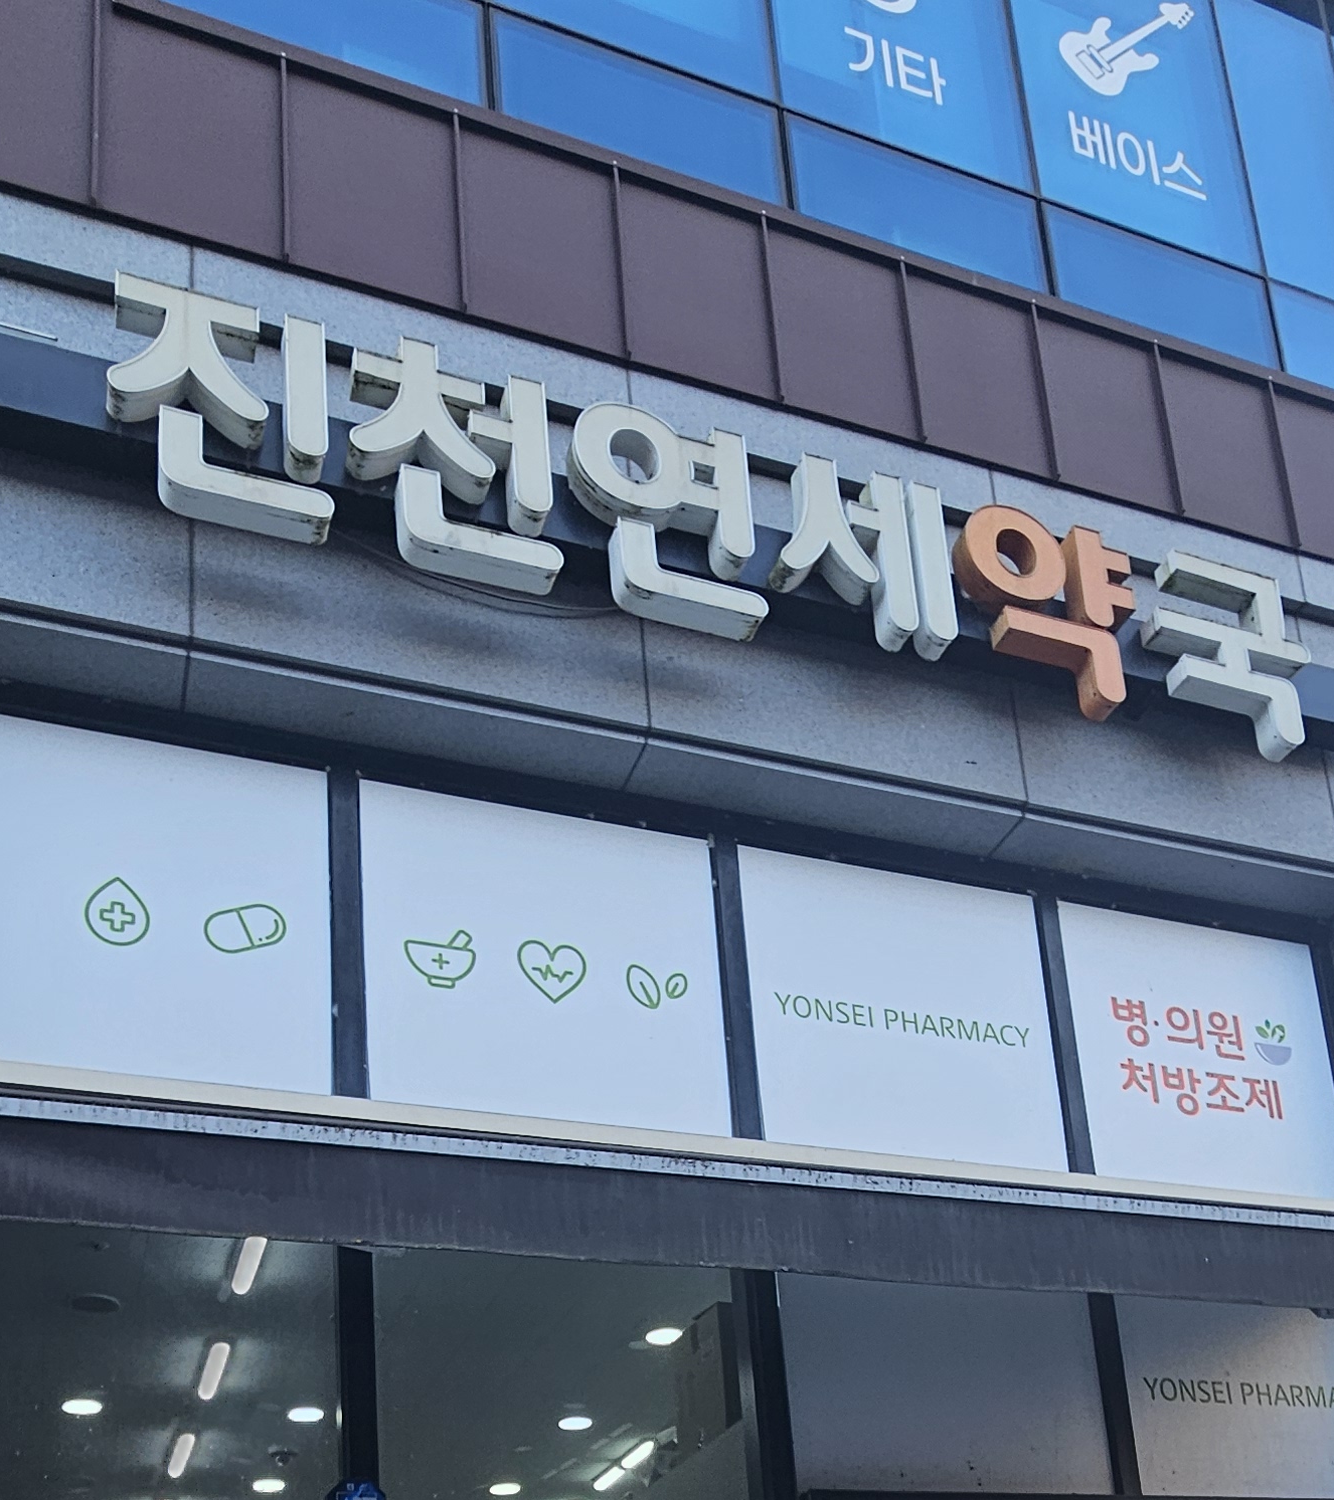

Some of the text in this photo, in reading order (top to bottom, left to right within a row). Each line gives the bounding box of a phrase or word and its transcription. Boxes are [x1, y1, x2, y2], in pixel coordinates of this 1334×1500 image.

[843, 26, 948, 105] 기타
[1067, 110, 1208, 201] 베이스
[107, 270, 1314, 763] 진천연세약국
[773, 991, 1031, 1049] YONSEI PHARMACY
[1110, 996, 1246, 1062] 병·의원
[1120, 1056, 1285, 1120] 처방조제
[1142, 1376, 1234, 1405] YONSEI
